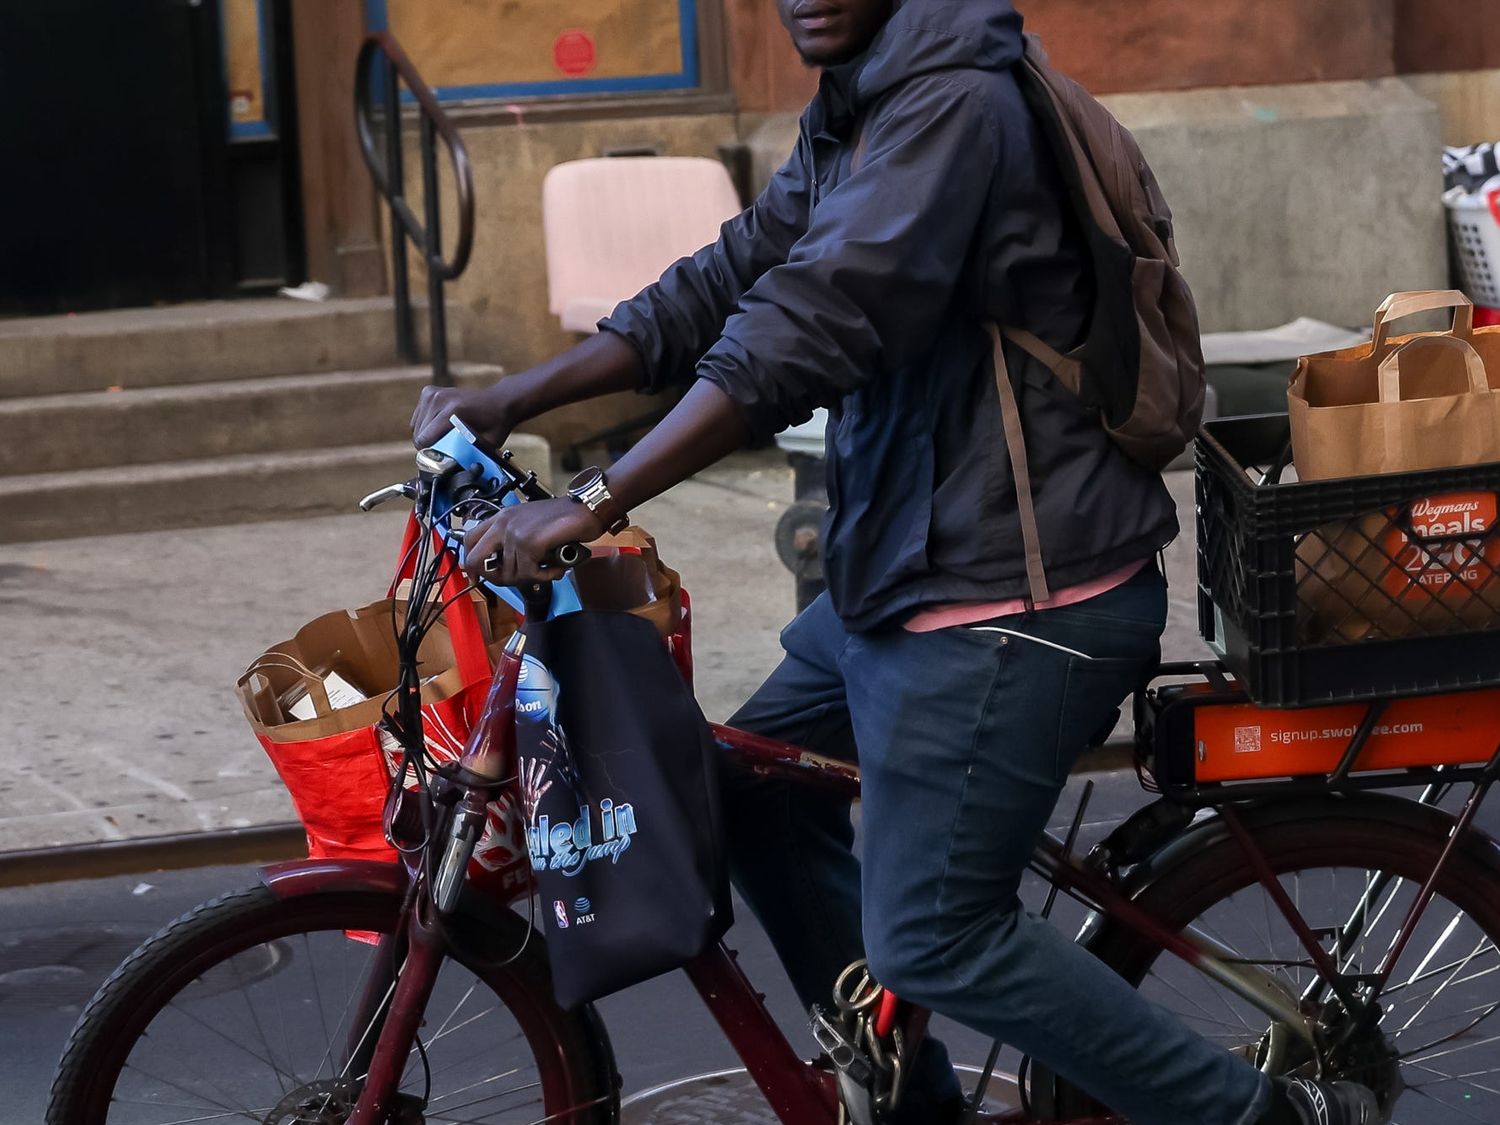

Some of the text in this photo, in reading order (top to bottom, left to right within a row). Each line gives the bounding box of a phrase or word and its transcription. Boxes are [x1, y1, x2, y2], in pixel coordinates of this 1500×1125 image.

[1411, 498, 1479, 522] Wegmans
[1270, 722, 1424, 744] signup.swoee.com
[600, 798, 637, 841] in
[576, 913, 596, 925] AT&T
